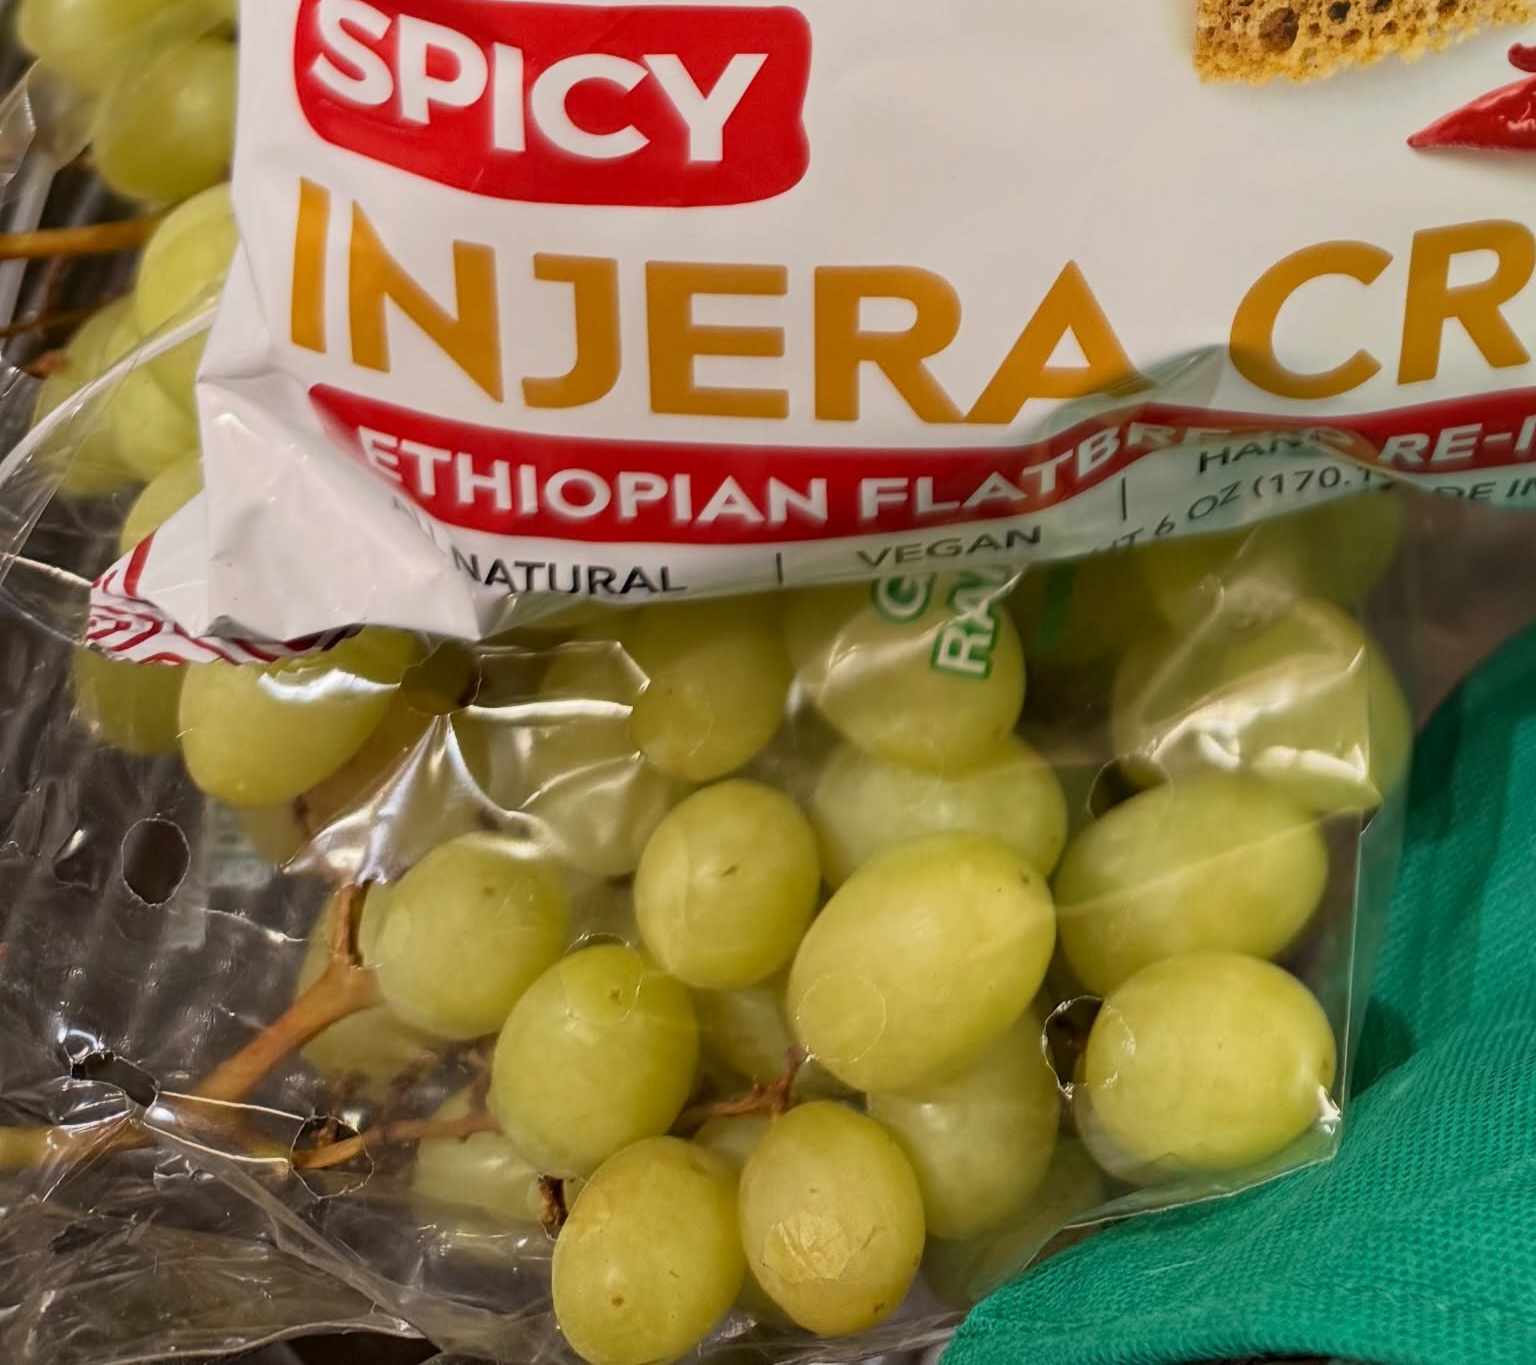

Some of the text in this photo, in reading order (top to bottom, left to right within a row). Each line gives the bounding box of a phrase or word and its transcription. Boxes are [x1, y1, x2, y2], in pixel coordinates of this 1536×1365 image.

[290, 176, 1163, 424] INJERA
[359, 425, 829, 525] ETHIOPIAN
[859, 422, 1355, 520] FLATBR
[1187, 480, 1242, 521] OZ
[1253, 464, 1395, 500] (170.1
[451, 544, 688, 595] NATURAL
[857, 525, 1041, 567] VEGAN
